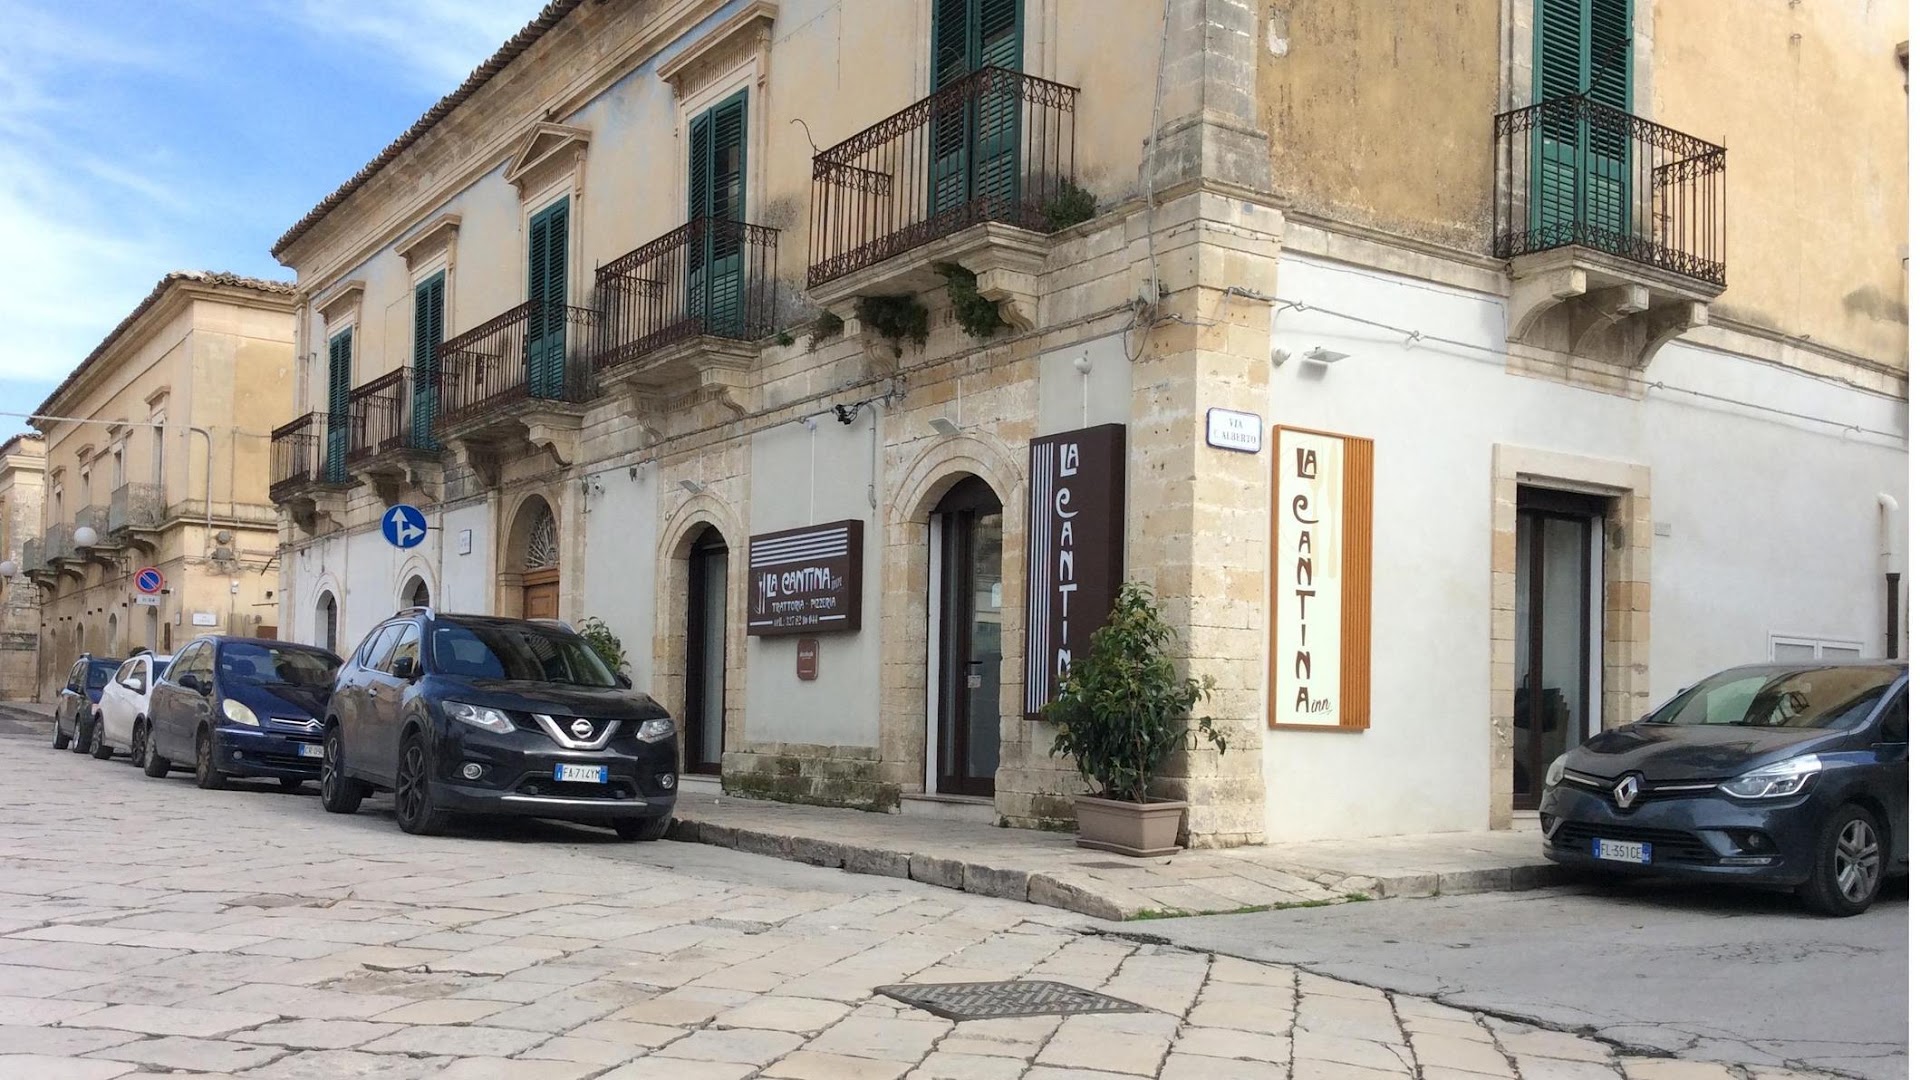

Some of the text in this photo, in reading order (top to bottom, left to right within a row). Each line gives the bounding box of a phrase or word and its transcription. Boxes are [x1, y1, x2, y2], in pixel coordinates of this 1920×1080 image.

[1222, 431, 1257, 444] ALBERTO
[1229, 418, 1243, 428] VIA
[1059, 443, 1079, 477] LA
[1296, 447, 1317, 479] LA
[766, 573, 778, 597] LA
[781, 567, 831, 595] CANTINA
[772, 599, 805, 613] TRATTORIA
[810, 596, 836, 609] PIZZERIA
[1293, 494, 1332, 714] CANTINA inn
